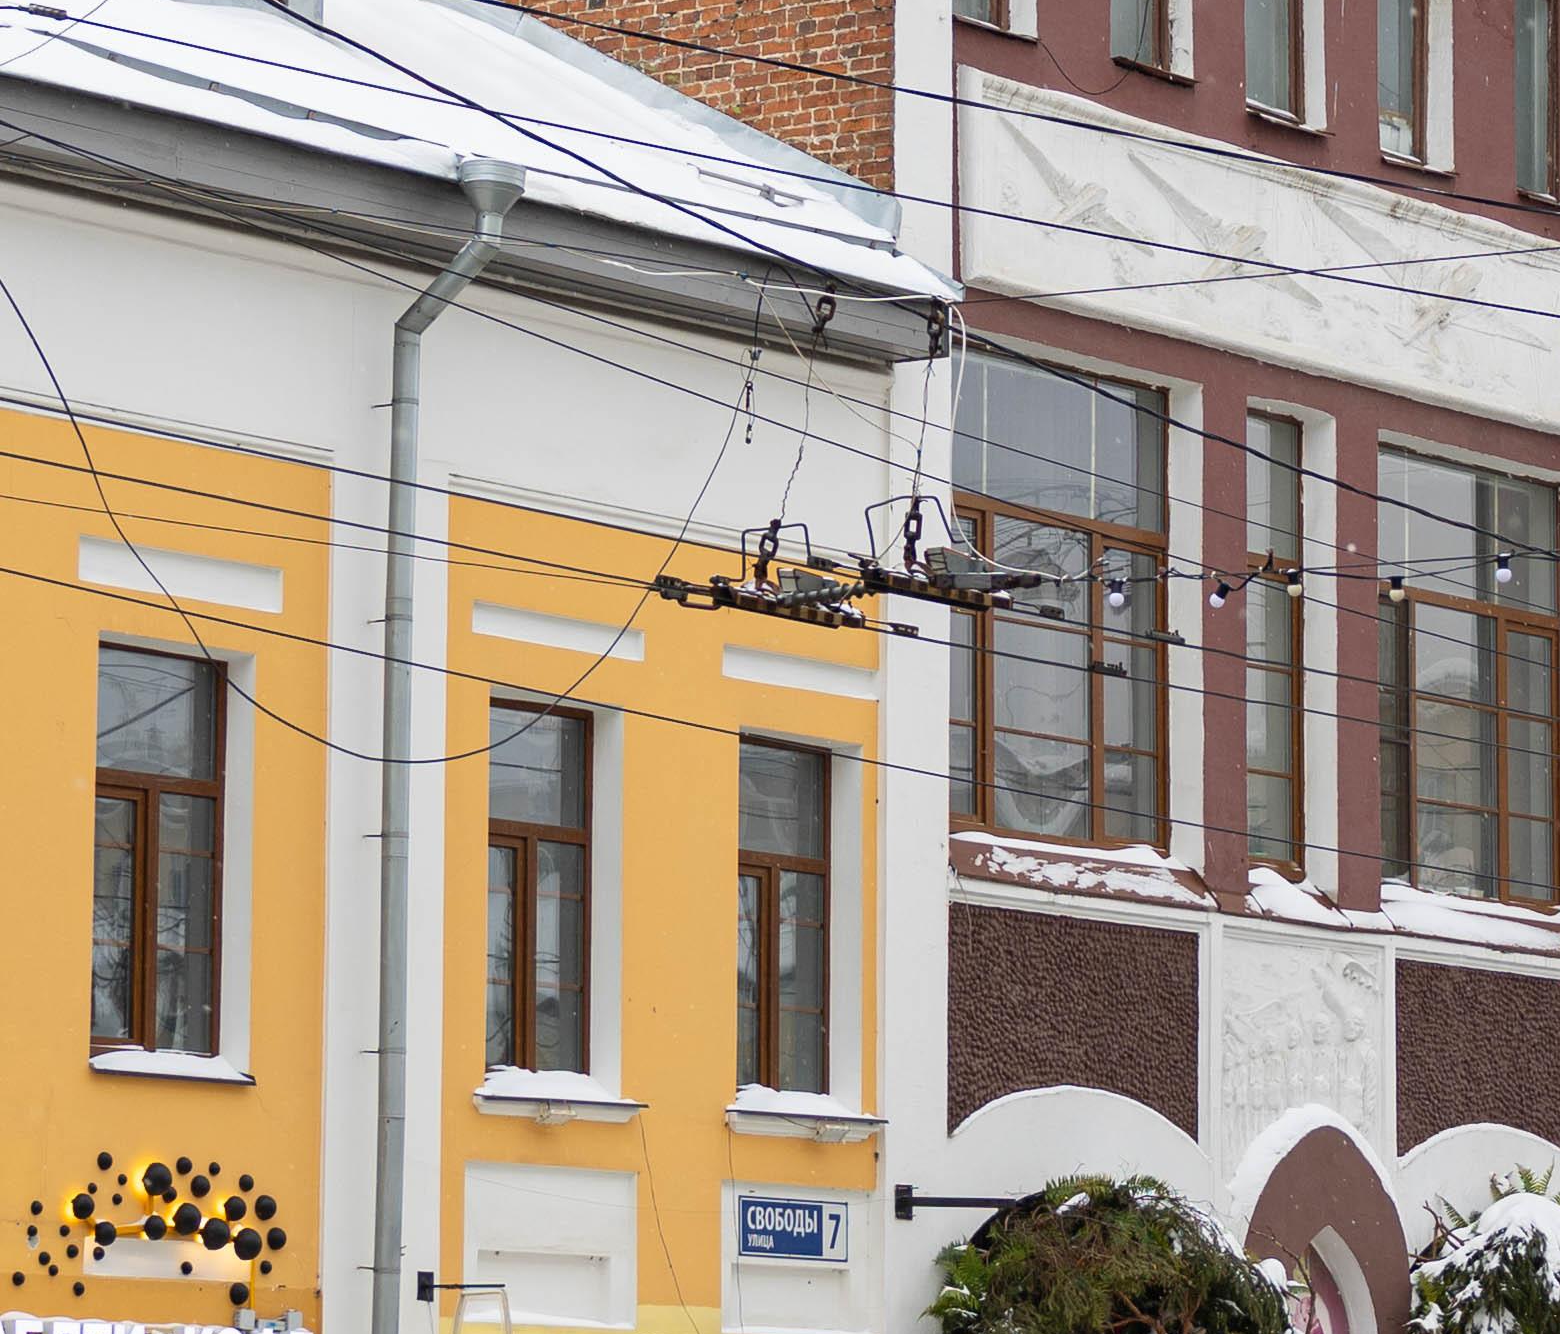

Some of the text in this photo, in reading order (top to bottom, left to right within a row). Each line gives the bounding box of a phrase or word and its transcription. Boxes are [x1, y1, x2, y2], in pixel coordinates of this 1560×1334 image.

[747, 1206, 841, 1249] СВОБОДЫ 7
[747, 1233, 775, 1250] УЛИЦА
